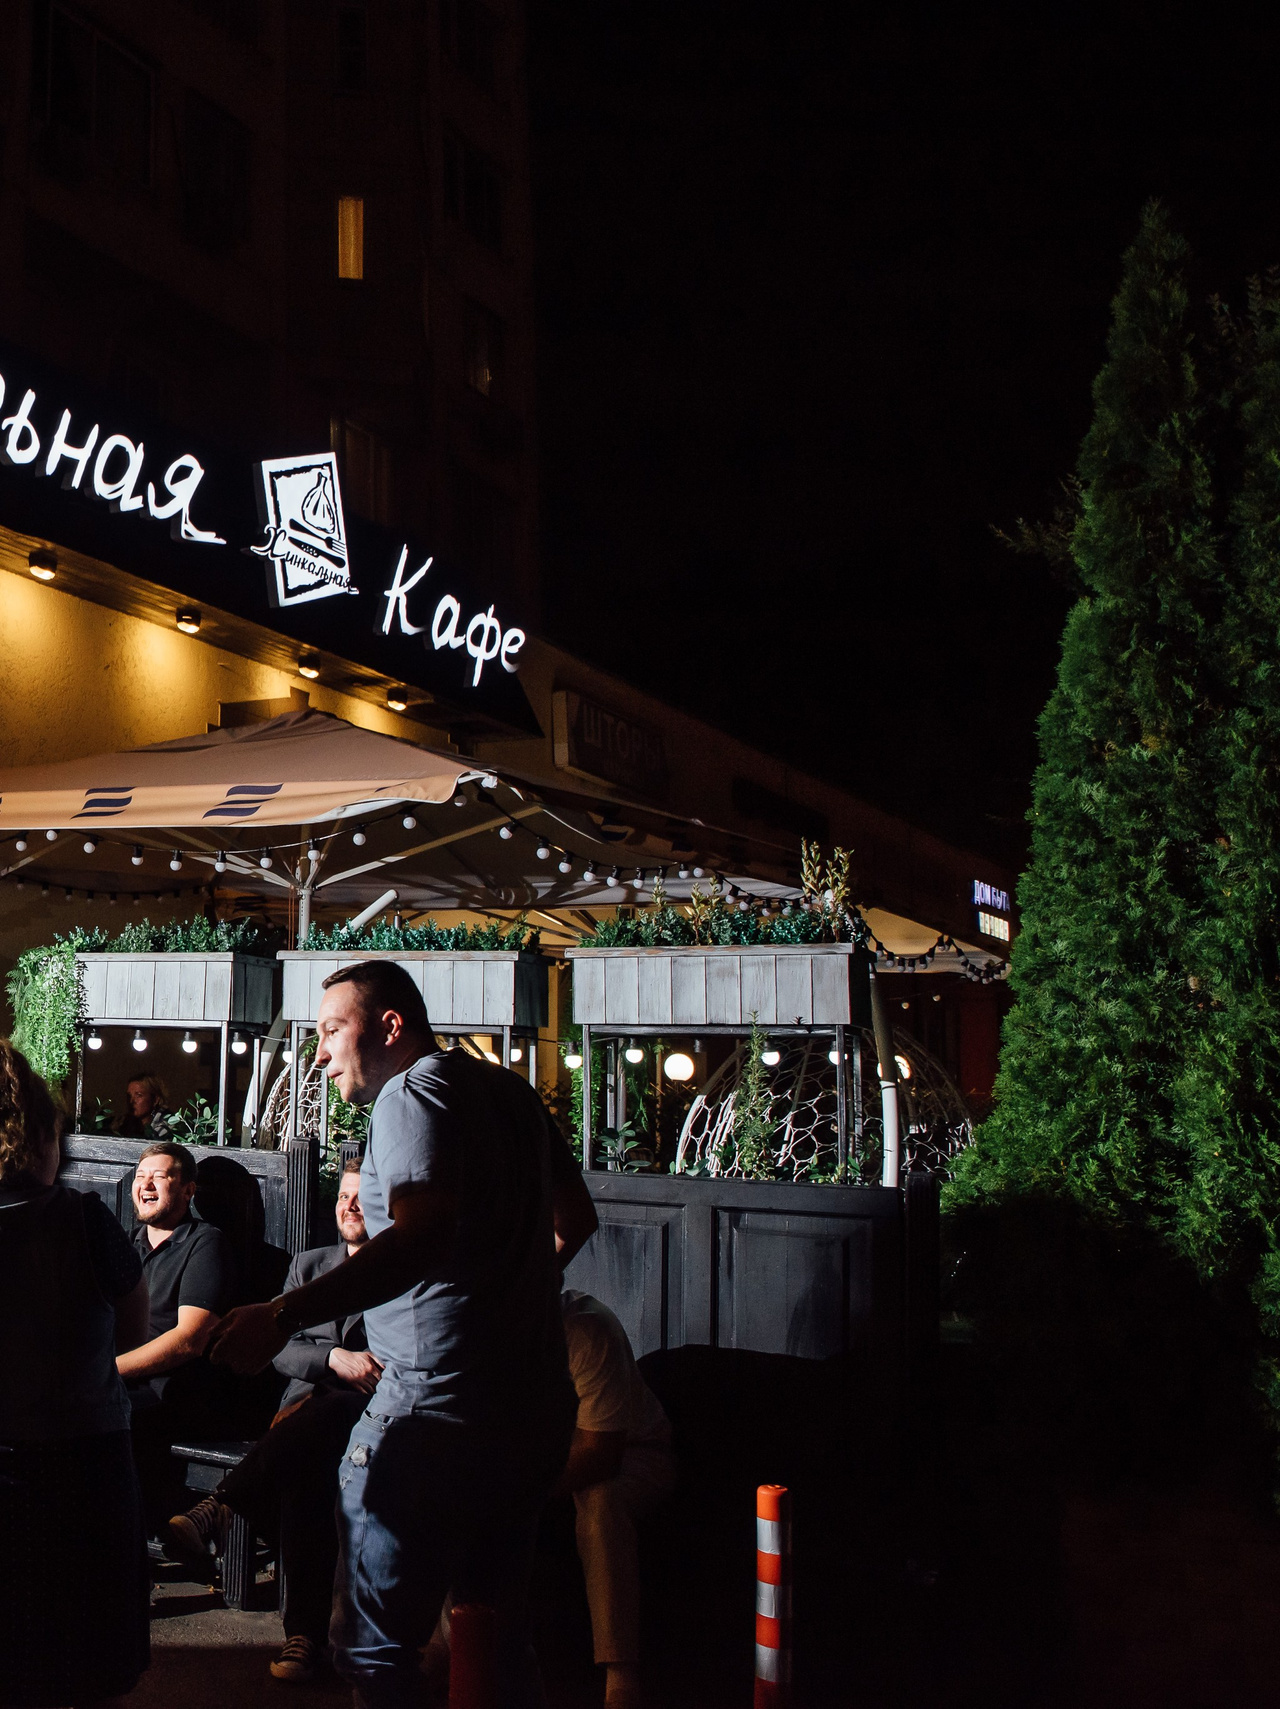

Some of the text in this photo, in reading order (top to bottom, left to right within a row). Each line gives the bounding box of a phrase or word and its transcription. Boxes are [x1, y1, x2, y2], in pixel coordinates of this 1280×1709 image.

[250, 523, 360, 595] Хинкальная
[382, 543, 526, 687] Кафе
[974, 879, 991, 906] ДОМ
